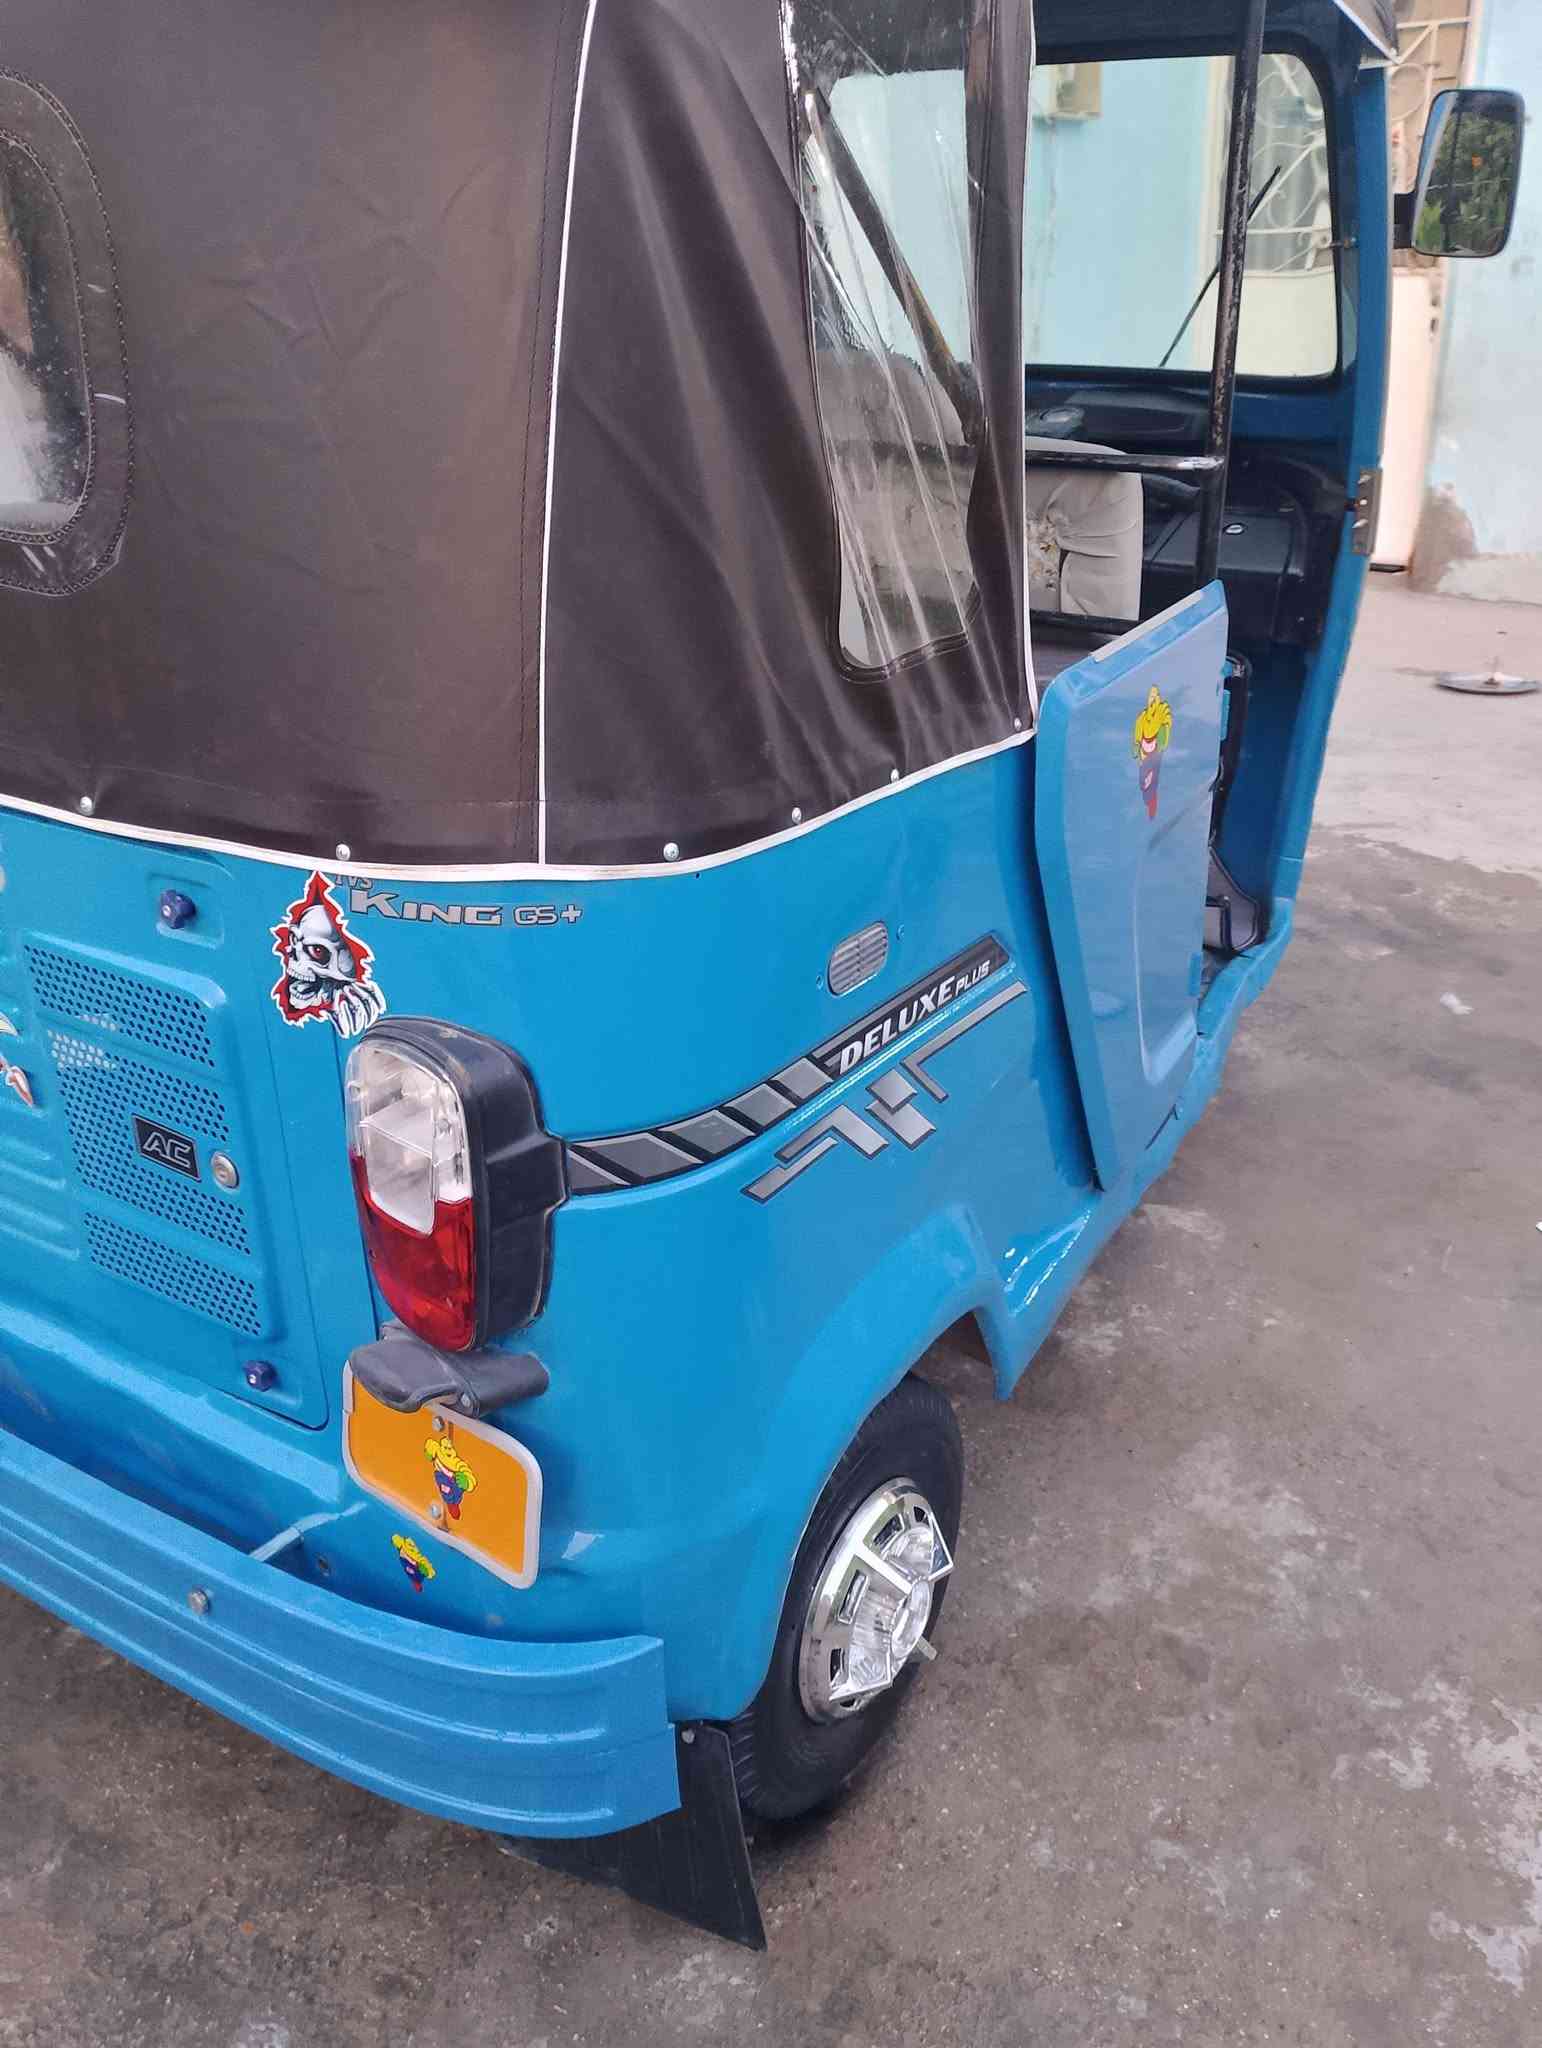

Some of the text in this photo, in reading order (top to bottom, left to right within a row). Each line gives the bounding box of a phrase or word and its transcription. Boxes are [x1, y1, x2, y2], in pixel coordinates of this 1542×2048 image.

[350, 888, 583, 926] KING GS+
[838, 960, 990, 1076] DELUXE PLUS
